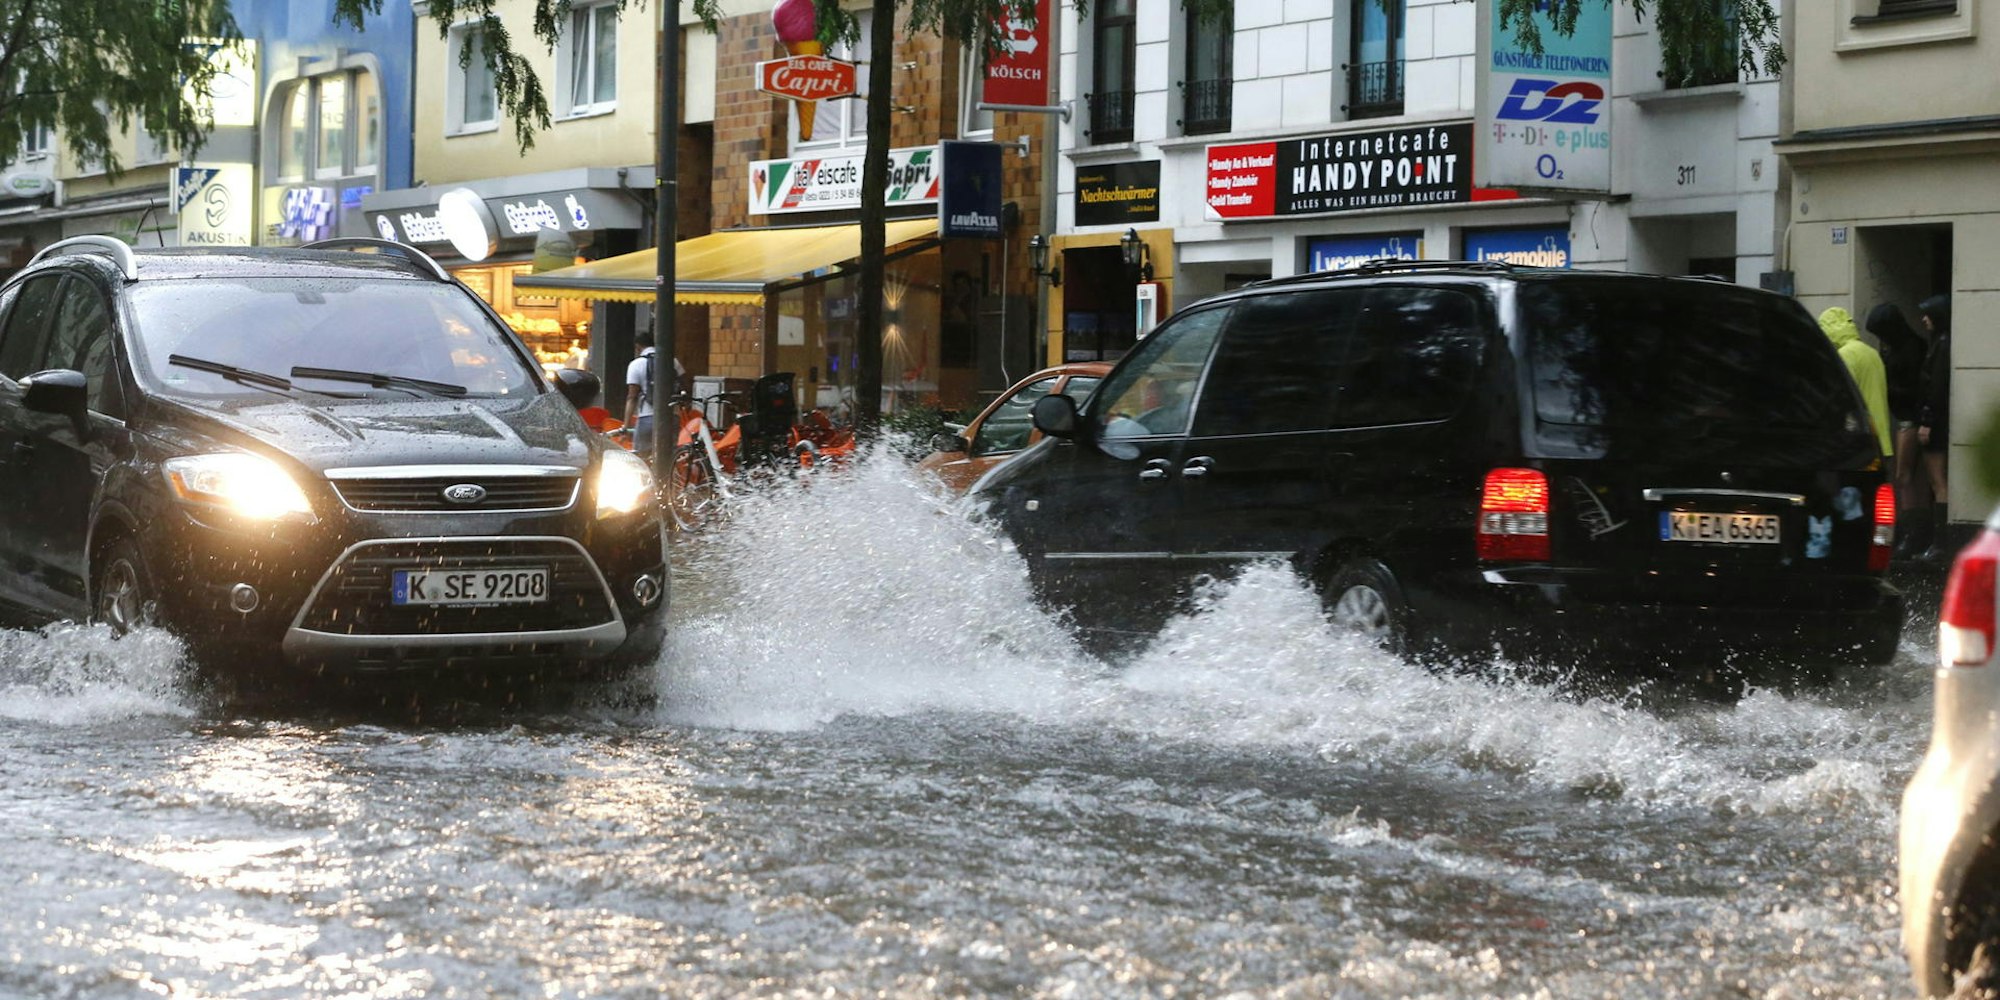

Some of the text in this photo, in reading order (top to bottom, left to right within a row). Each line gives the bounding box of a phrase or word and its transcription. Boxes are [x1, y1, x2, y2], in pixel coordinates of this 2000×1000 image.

[788, 60, 806, 71] EIS
[990, 64, 1041, 80] KÖLSCH
[1545, 54, 1609, 73] TELEFONIEREN
[771, 66, 848, 96] Capri
[1496, 78, 1604, 125] D2
[1300, 127, 1449, 162] Internetcafe
[1292, 154, 1457, 195] HANDY POINT
[1677, 165, 1697, 185] 311
[1080, 185, 1157, 203] Nachtschwärmer
[1291, 190, 1457, 211] ALLES WAS EIN HANDY BRAUCHT
[1671, 515, 1776, 540] K EA 6365
[410, 573, 545, 600] K SE 9208
